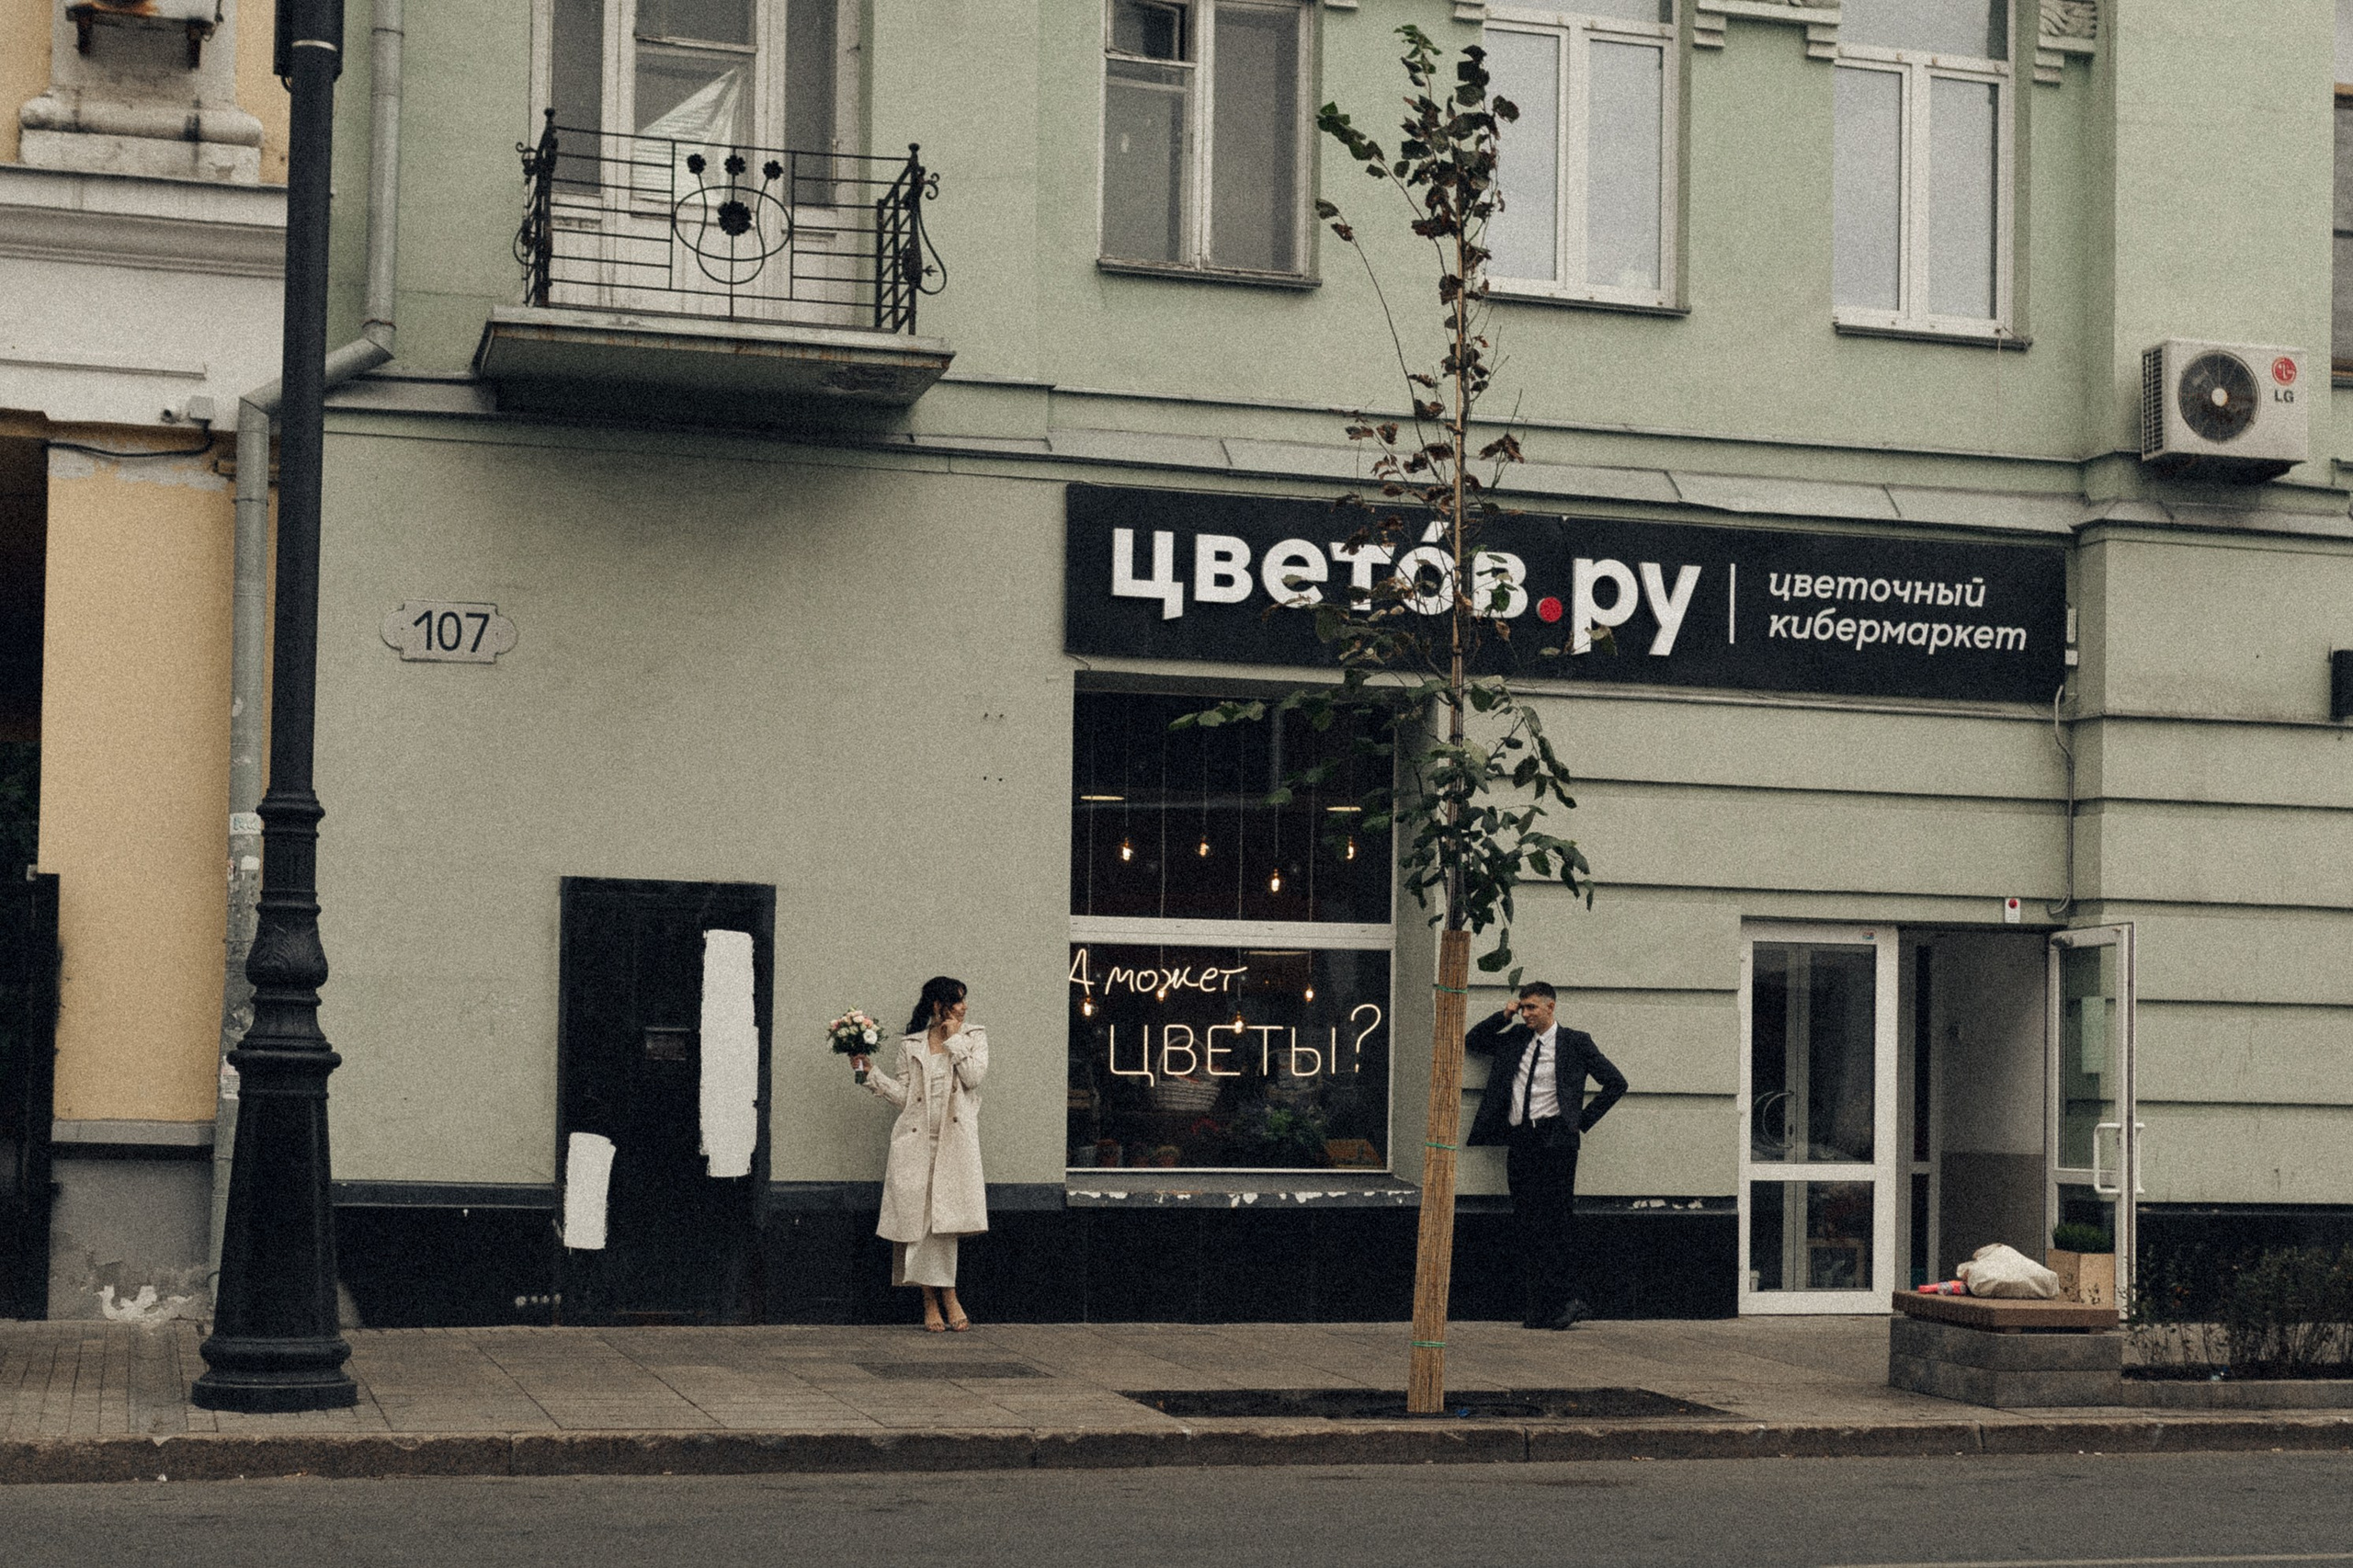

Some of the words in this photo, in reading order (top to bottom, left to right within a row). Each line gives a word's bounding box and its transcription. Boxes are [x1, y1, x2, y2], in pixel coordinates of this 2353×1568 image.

[2275, 390, 2294, 403] LG
[1768, 572, 1986, 608] цветочный
[414, 610, 489, 652] 107
[1768, 607, 2028, 655] кибермаркет
[1069, 948, 1095, 995] А
[1105, 965, 1248, 996] может
[1108, 1003, 1382, 1087] ЦВЕТЫ?
